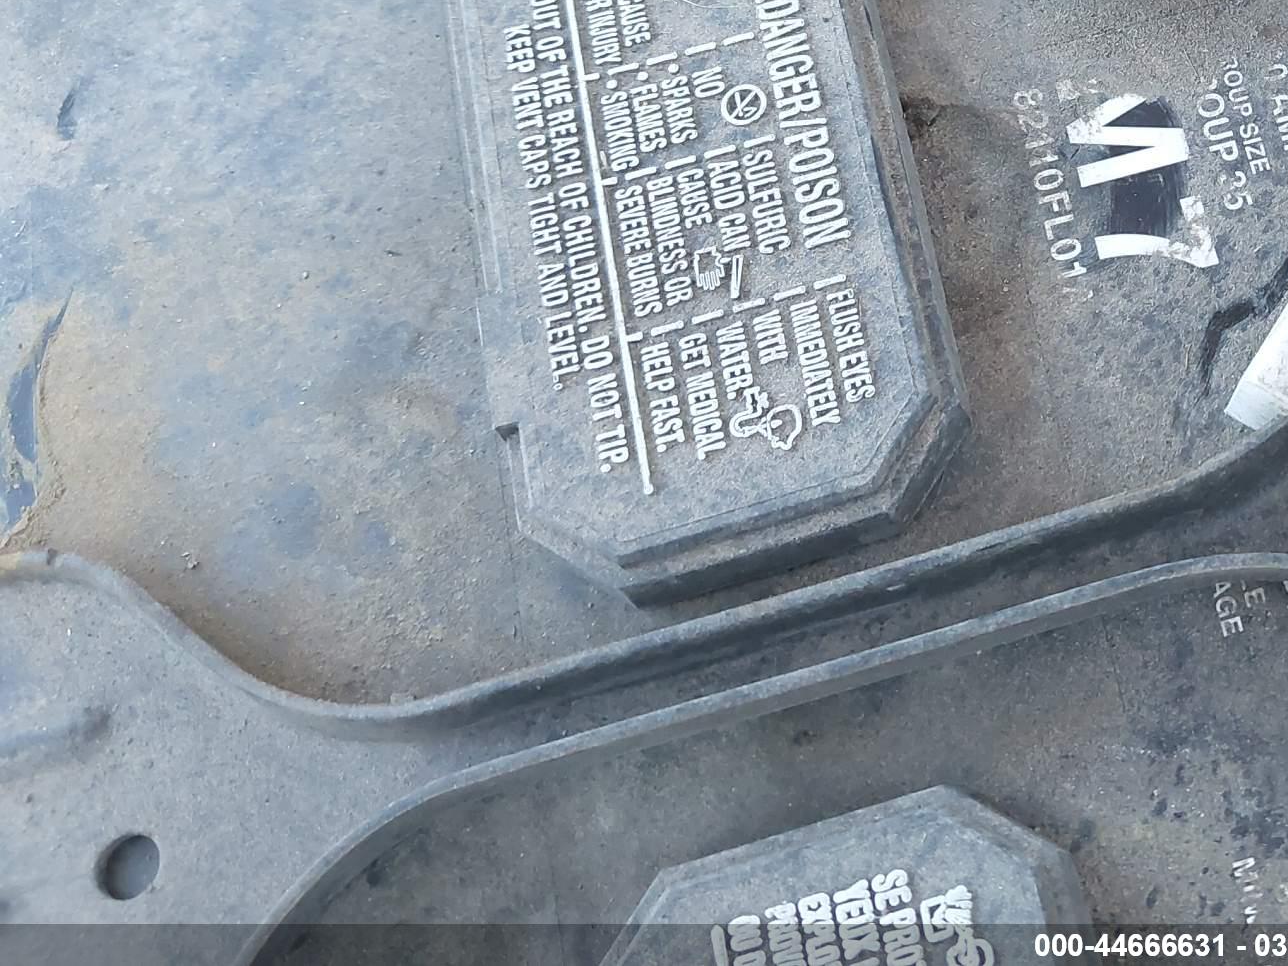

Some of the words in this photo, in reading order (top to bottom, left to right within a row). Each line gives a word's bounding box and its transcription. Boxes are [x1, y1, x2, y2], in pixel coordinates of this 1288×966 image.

[506, 25, 536, 72] KEEP
[537, 36, 566, 59] OF
[590, 11, 622, 64] INJURY
[512, 77, 544, 130] VENT
[541, 65, 572, 107] THE
[694, 67, 725, 98] NO
[602, 92, 640, 171] SMOKING
[632, 84, 667, 152] FLAMES
[663, 76, 698, 144] SPARKS
[520, 136, 552, 189] CAPS
[548, 109, 583, 176] REACH
[1240, 123, 1271, 175] SIZE
[559, 182, 589, 208] OF
[678, 168, 712, 228] CAUSE
[710, 160, 744, 209] ACID
[744, 150, 791, 254] SULFURIC
[529, 194, 562, 255] TIGHT
[616, 185, 651, 253] SEVERE
[648, 176, 688, 274] BLINDNESS
[720, 213, 750, 251] CAN
[539, 264, 569, 306] AND
[565, 216, 607, 331] CHILDREN.
[628, 253, 662, 316] BURNS
[665, 277, 694, 306] OR
[754, 310, 787, 364] WITH
[828, 289, 864, 352] FLUSH
[548, 312, 580, 390] LEVEL.
[583, 336, 613, 370] DO
[642, 343, 675, 393] HELP
[679, 333, 711, 370] GET
[791, 300, 840, 426] IMMEDIATELY
[840, 351, 875, 402] EYES
[589, 374, 622, 419] NOT
[687, 372, 727, 459] MEDICAL
[598, 425, 628, 472] TIP.
[651, 396, 685, 451] FAST.
[1212, 582, 1244, 638] AGE
[833, 878, 882, 961] YEUX
